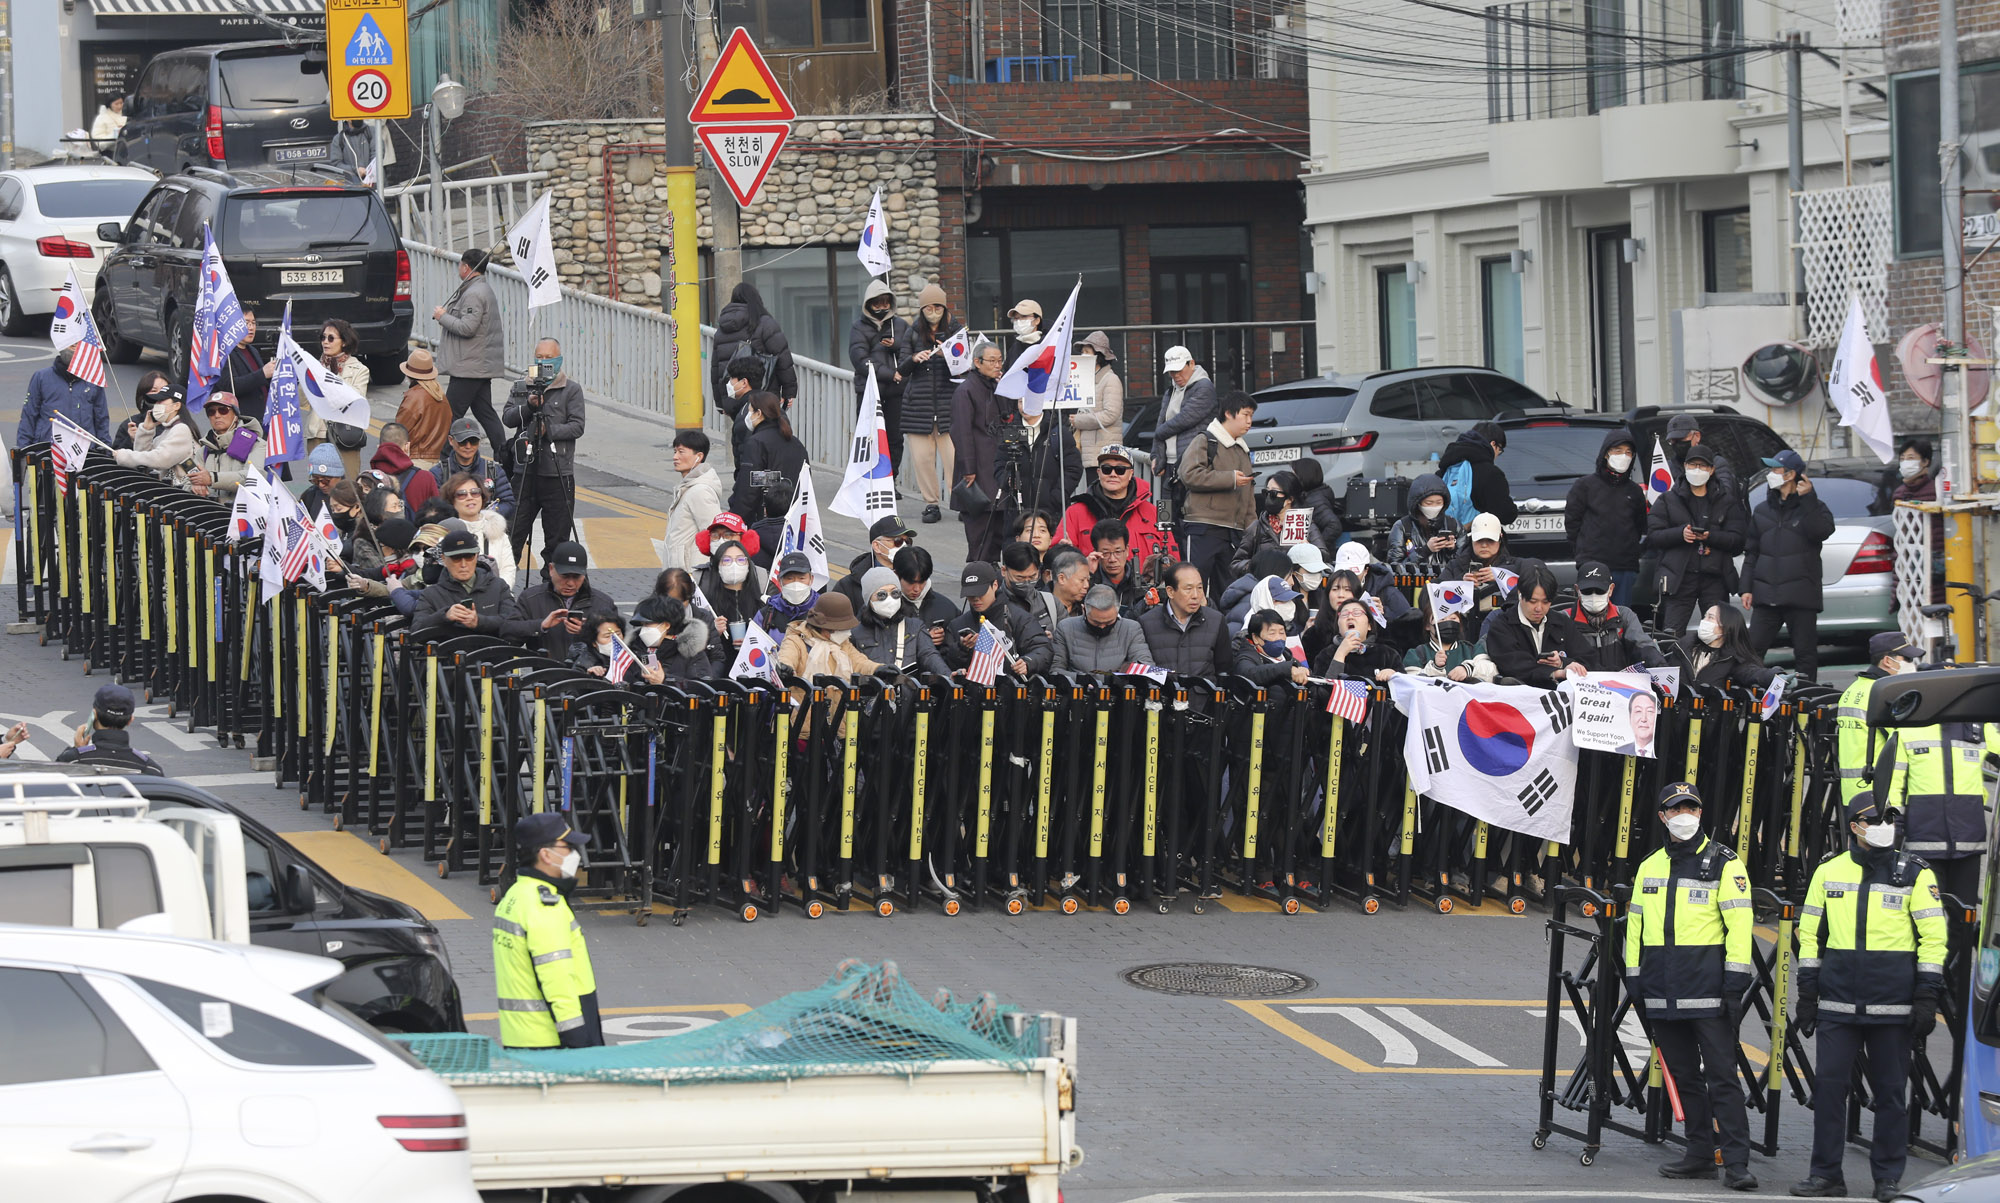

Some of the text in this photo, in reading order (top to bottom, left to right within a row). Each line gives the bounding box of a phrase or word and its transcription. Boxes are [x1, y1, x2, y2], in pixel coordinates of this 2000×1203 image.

[301, 16, 326, 25] CAFÉ
[352, 56, 388, 65] 어린이보호
[356, 81, 383, 100] 20
[724, 136, 763, 154] 천천히
[728, 155, 760, 167] SLOW
[311, 271, 338, 281] 8312
[1279, 449, 1298, 460] 2431
[1535, 518, 1563, 530] 5116
[1580, 696, 1611, 709] Great
[1578, 711, 1615, 723] Again!
[1586, 729, 1609, 738] Support
[1610, 733, 1626, 742] Yoon,
[1592, 737, 1618, 746] President
[780, 741, 788, 798] POLICE
[918, 739, 926, 796] POLICE
[1043, 738, 1053, 795] POLICE
[1147, 736, 1156, 793] POLICE
[844, 737, 857, 844] 질서유지선
[980, 737, 993, 843] 질서유지선
[1093, 736, 1107, 842] 질서유지선
[1248, 739, 1264, 844] 질서유지선
[1326, 739, 1341, 843] POLICE LINE
[1741, 748, 1756, 851] POLICE LINE
[1620, 806, 1628, 843] LINE
[1775, 951, 1790, 1072] POLICE LINE
